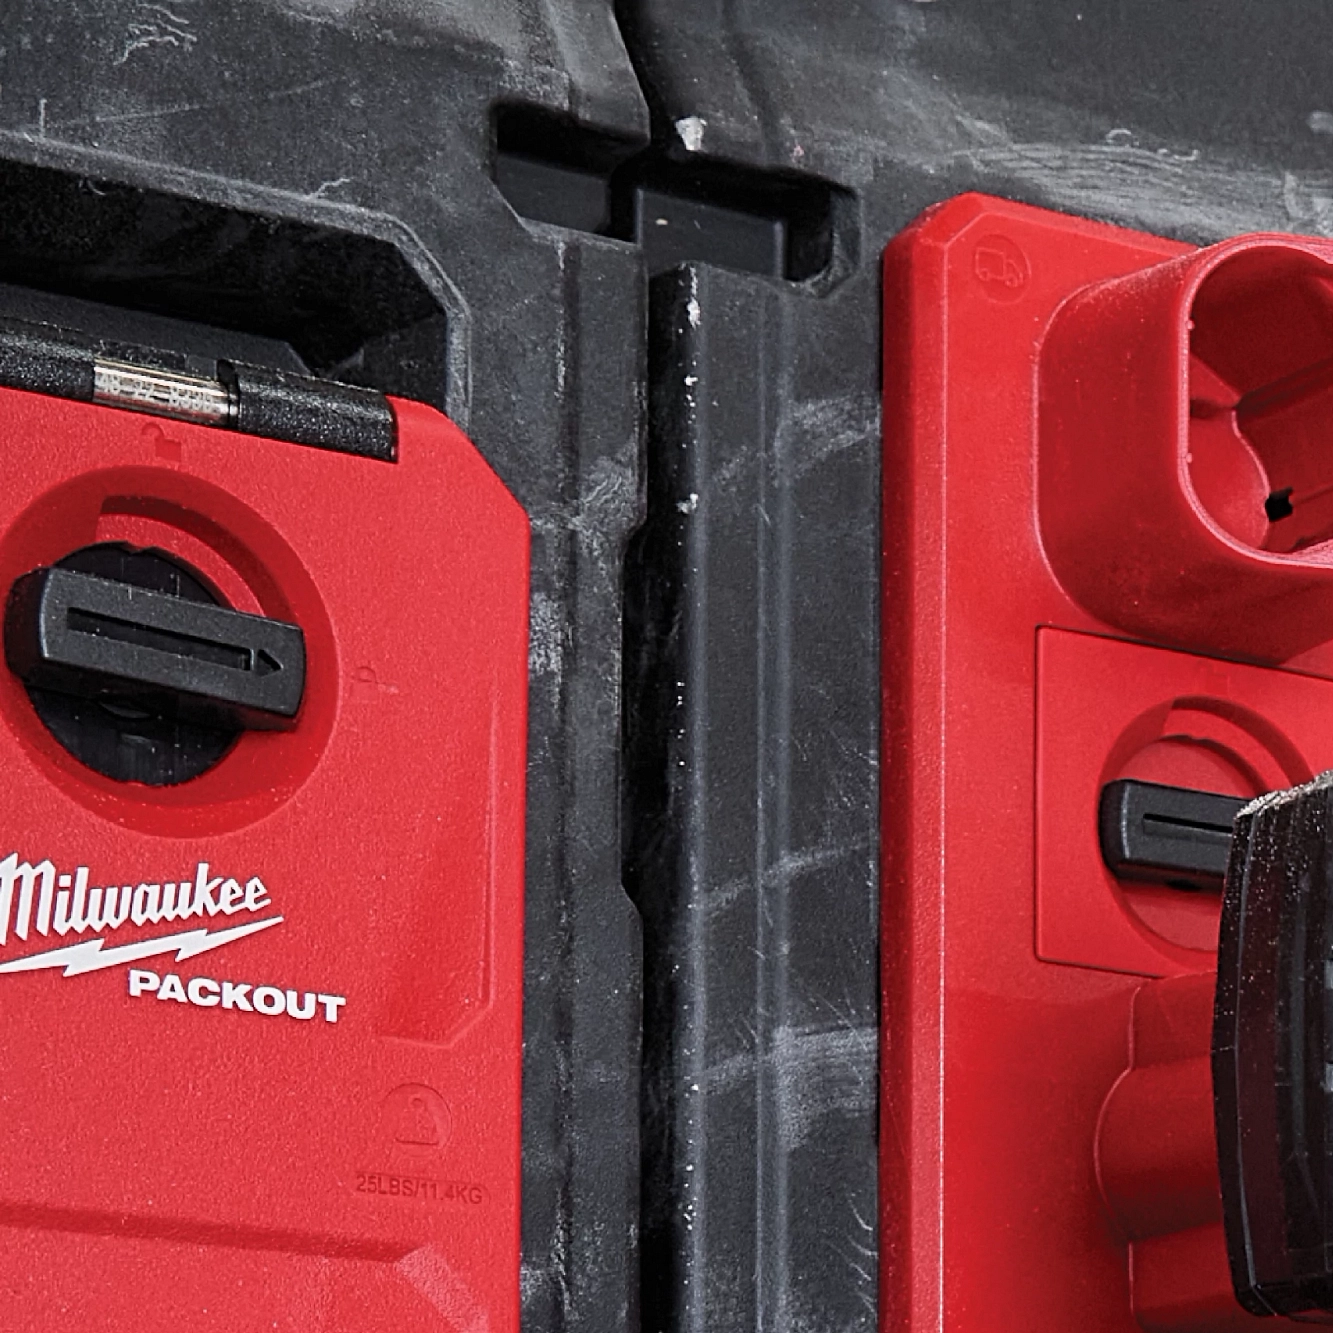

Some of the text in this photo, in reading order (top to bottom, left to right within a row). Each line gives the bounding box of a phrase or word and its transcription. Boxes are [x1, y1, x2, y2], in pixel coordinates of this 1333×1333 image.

[0, 852, 271, 945] Milwaukee
[129, 969, 347, 1023] PACKOUT
[356, 1174, 483, 1204] 25LBS/11.4KG
